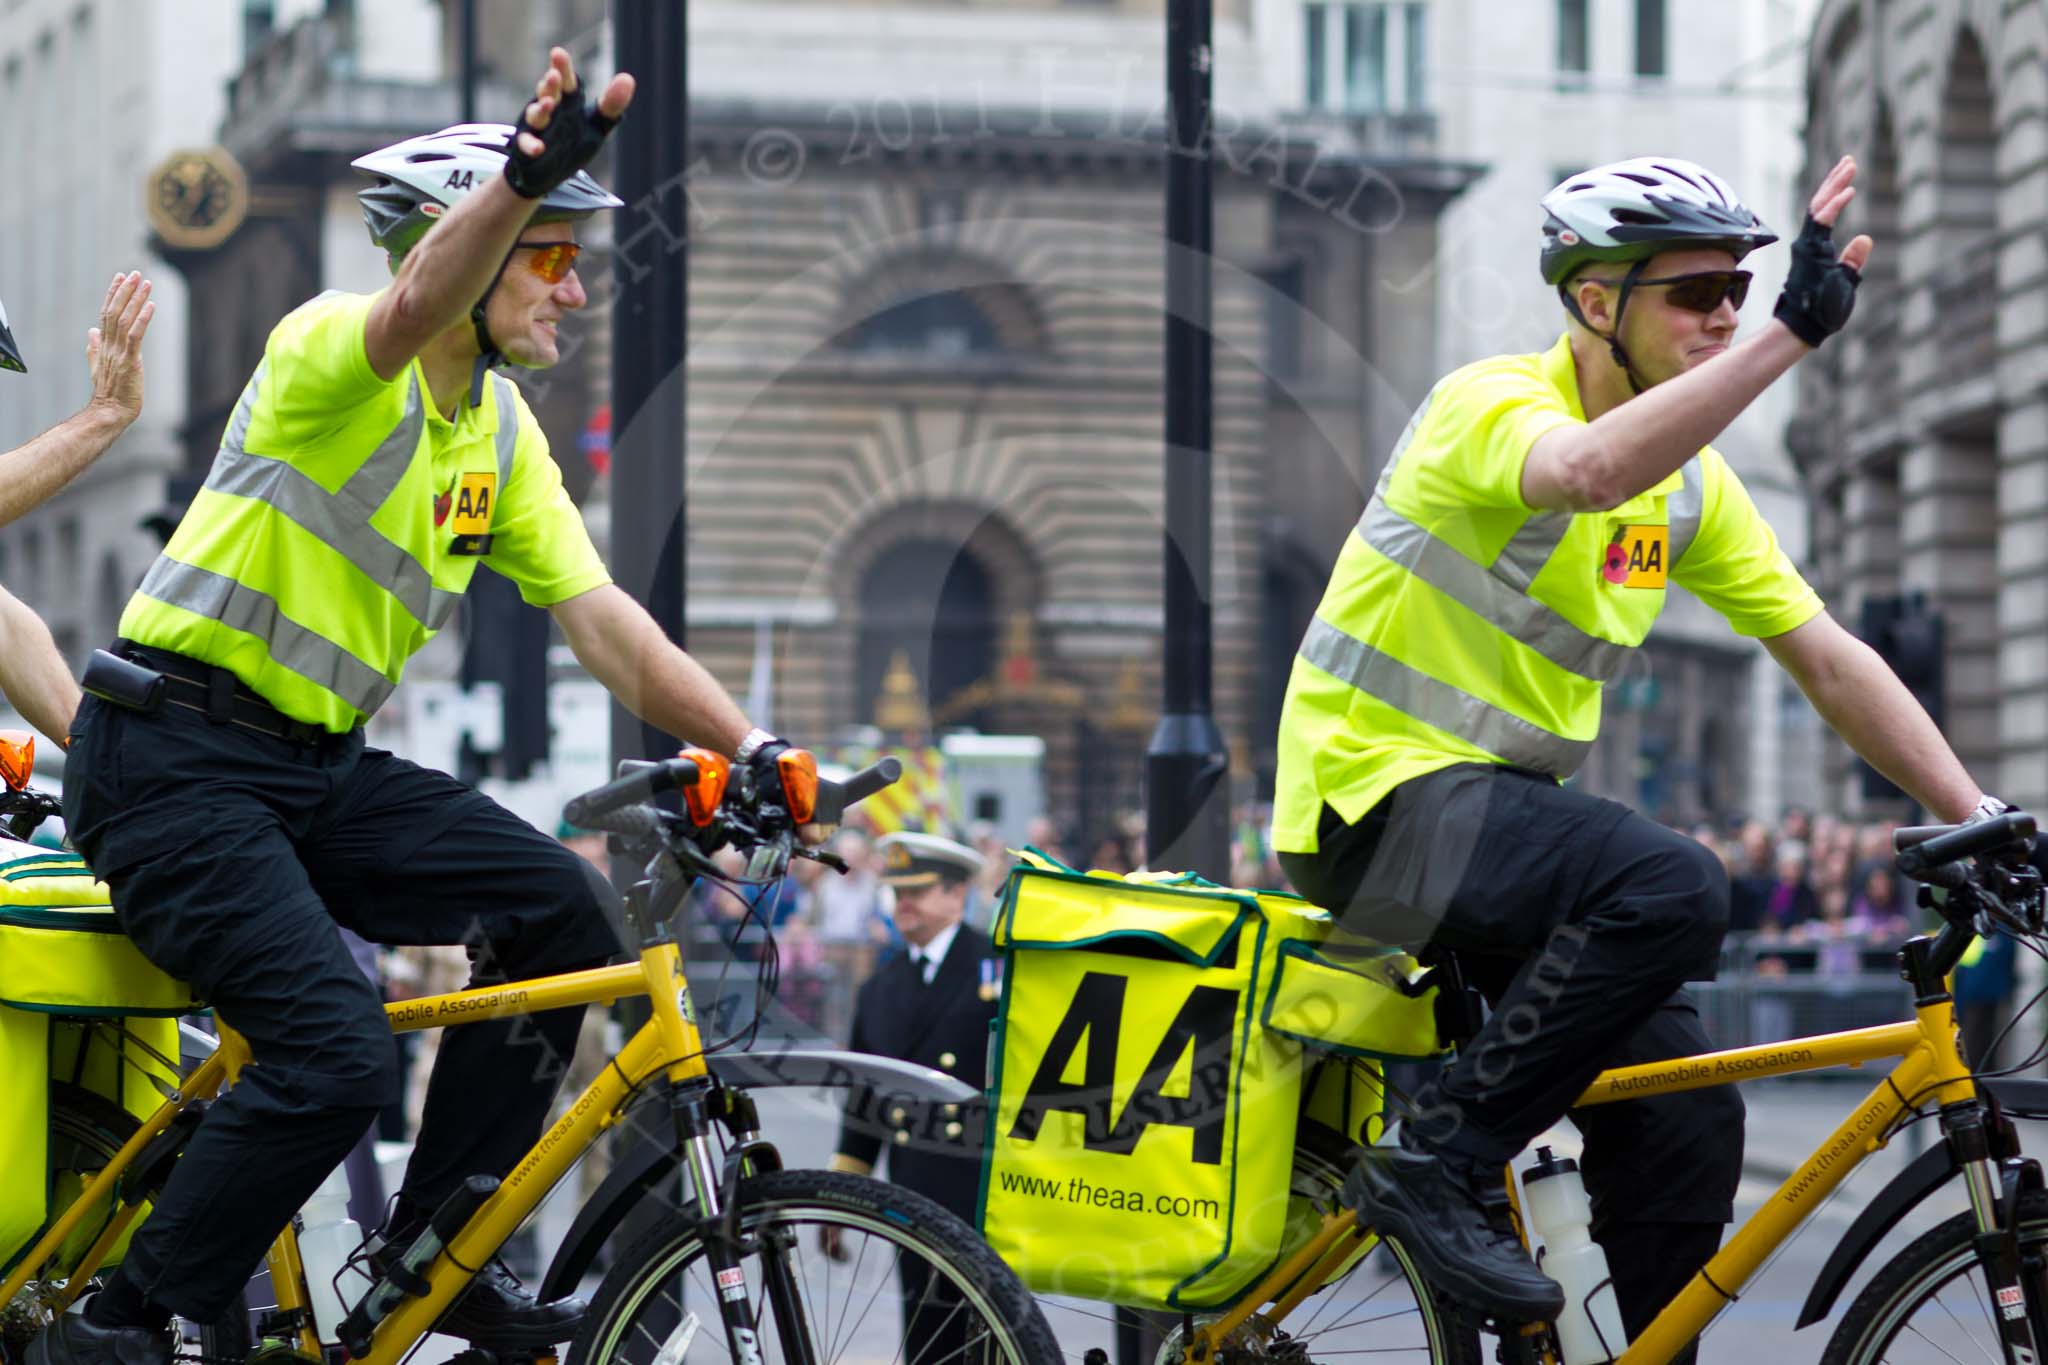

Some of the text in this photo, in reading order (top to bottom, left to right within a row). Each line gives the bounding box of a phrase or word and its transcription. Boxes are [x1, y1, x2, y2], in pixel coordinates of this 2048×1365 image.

[443, 169, 473, 191] AA
[456, 487, 489, 519] AA
[1628, 539, 1662, 573] AA
[438, 989, 529, 1016] Association
[1007, 970, 1241, 1166] AA
[1609, 1047, 1814, 1094] Automobile Association
[509, 1085, 603, 1189] www.theaa.com
[1783, 1100, 1888, 1204] www.theaa.com
[1000, 1170, 1219, 1220] www.theaa.com
